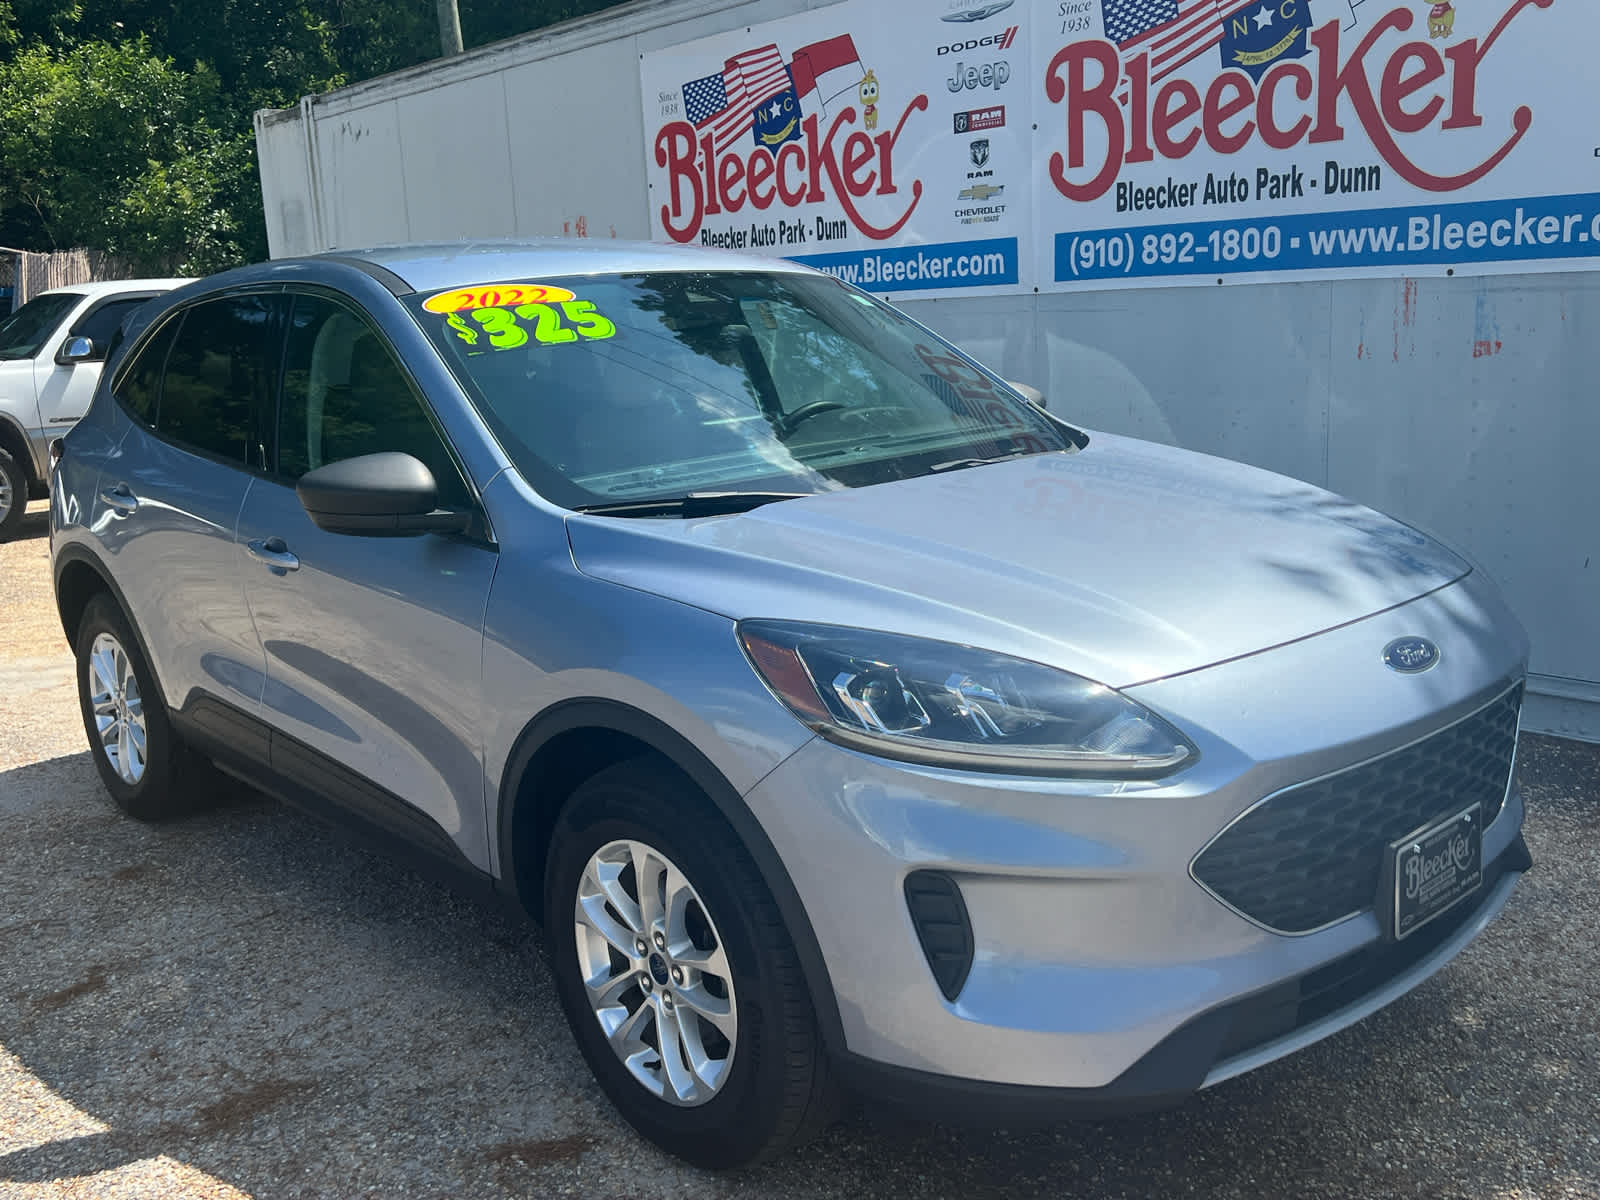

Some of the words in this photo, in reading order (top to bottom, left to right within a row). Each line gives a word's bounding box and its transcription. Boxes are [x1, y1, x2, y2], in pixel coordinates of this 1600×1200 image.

[1058, 1, 1092, 16] Since
[1232, 16, 1248, 39] N
[1280, 0, 1297, 19] C
[1061, 16, 1091, 34] 1938
[937, 33, 1007, 56] DODGE
[946, 61, 1010, 93] Jeep
[757, 108, 769, 125] N
[783, 97, 794, 112] C
[972, 110, 1002, 122] RAM
[1045, 0, 1554, 202] Bleecker
[655, 94, 928, 243] Bleecker
[967, 169, 993, 179] RAM
[1116, 178, 1198, 213] Bleecker
[1203, 172, 1249, 206] Auto
[1256, 167, 1304, 201] Park
[1325, 161, 1382, 195] Dunn
[954, 205, 1006, 218] CHEVROLET
[701, 226, 748, 250] Bleecker
[750, 223, 776, 248] Auto
[779, 219, 806, 244] Park
[816, 216, 847, 241] Dunn
[1069, 232, 1135, 275] (910)
[1141, 226, 1281, 266] 892-1800
[817, 252, 1005, 284] ww.Bleecker.com
[455, 288, 549, 312] 2022
[447, 300, 616, 350] $325
[1396, 642, 1431, 665] Ford
[1405, 823, 1476, 899] Bleecker
